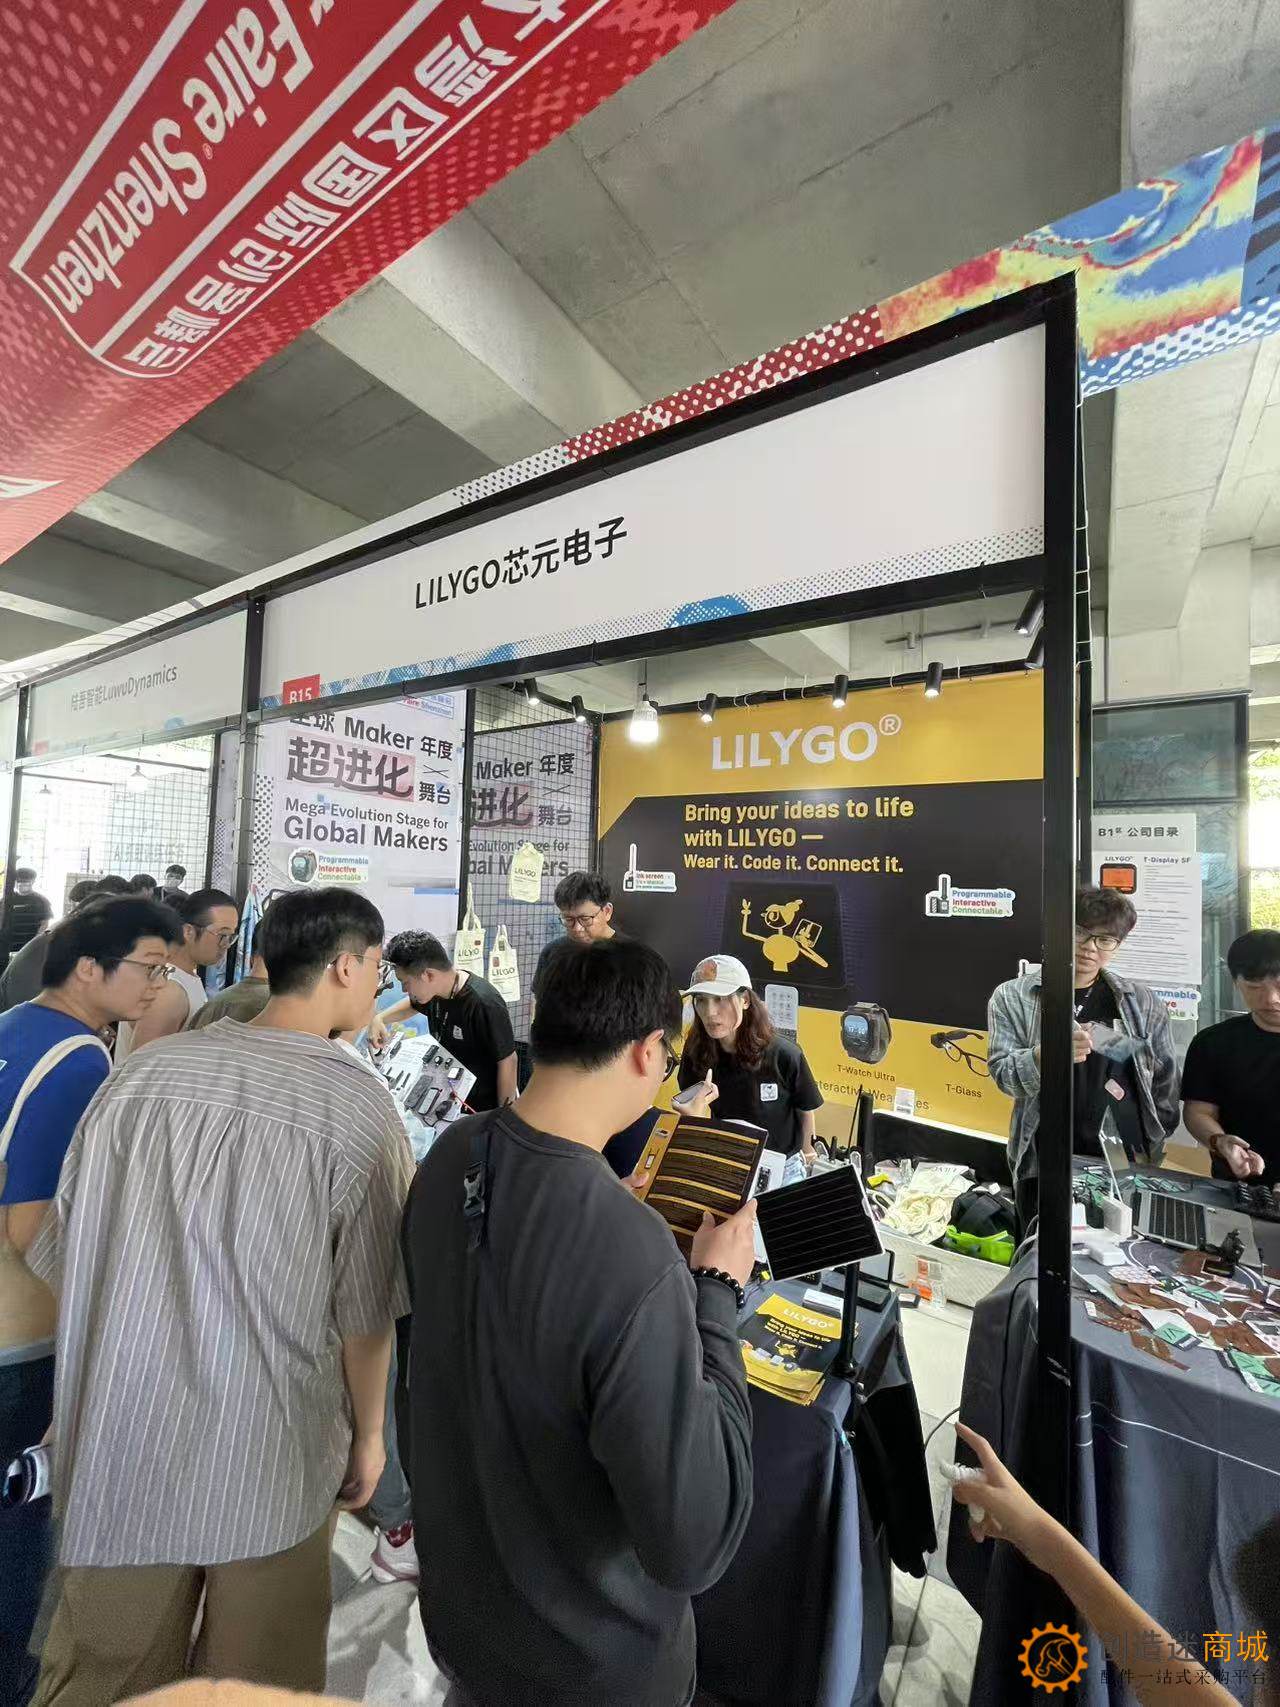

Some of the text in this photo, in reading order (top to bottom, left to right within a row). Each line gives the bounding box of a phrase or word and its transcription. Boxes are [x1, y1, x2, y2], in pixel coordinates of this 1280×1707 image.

[42, 117, 208, 314] Shenzhen
[415, 516, 628, 609] LILYGO芯元电子
[344, 716, 415, 751] Maker
[420, 736, 453, 761] 年度
[286, 736, 414, 798] 超进化
[476, 753, 575, 779] Maker 年度
[419, 781, 451, 805] 舞台
[285, 797, 449, 829] Mega Evolution Stage for
[538, 805, 573, 826] 舞台
[684, 796, 915, 824] Bring your ideas to life
[284, 815, 448, 851] Global Makers
[684, 830, 722, 847] with
[727, 828, 796, 847] LILYGO
[1127, 826, 1179, 838] 公司目录
[553, 839, 570, 851] for
[684, 854, 904, 873] Wear it. Code it. Connect it.
[952, 889, 1012, 898] Programmable
[952, 899, 996, 907] Interactive
[952, 906, 1003, 915] Connectable
[836, 1063, 896, 1082] T-Watch Ultra
[945, 1083, 983, 1098] T-Glass
